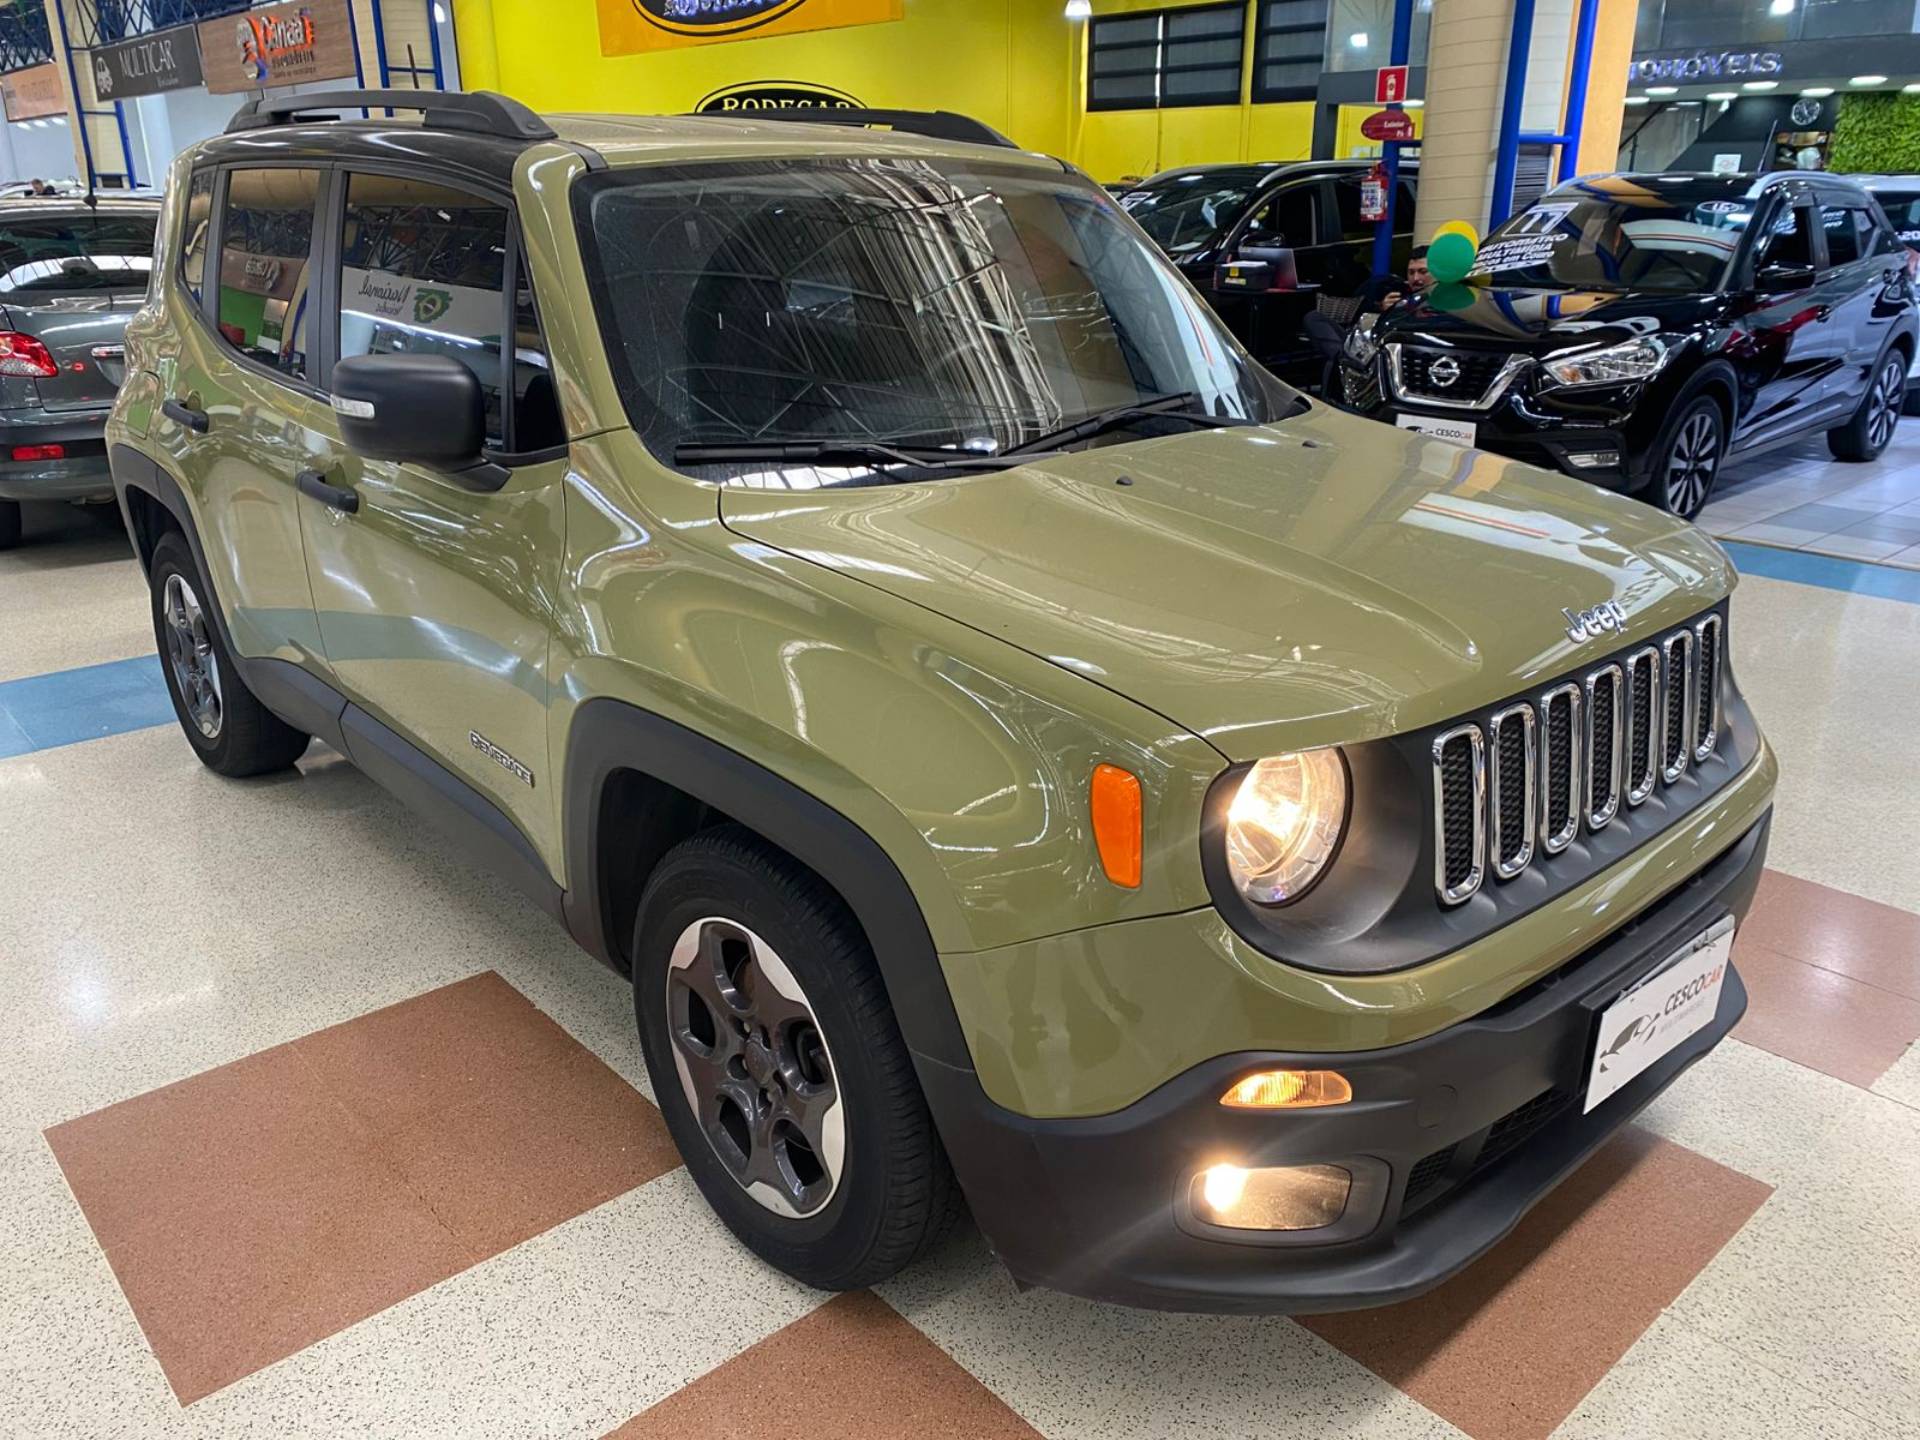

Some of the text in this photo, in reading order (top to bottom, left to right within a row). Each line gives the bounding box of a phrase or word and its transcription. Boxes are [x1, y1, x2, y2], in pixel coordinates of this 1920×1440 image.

[119, 40, 176, 77] MULTICAR
[1561, 600, 1627, 643] Jeep
[1664, 964, 1723, 1016] CESCOCAR
